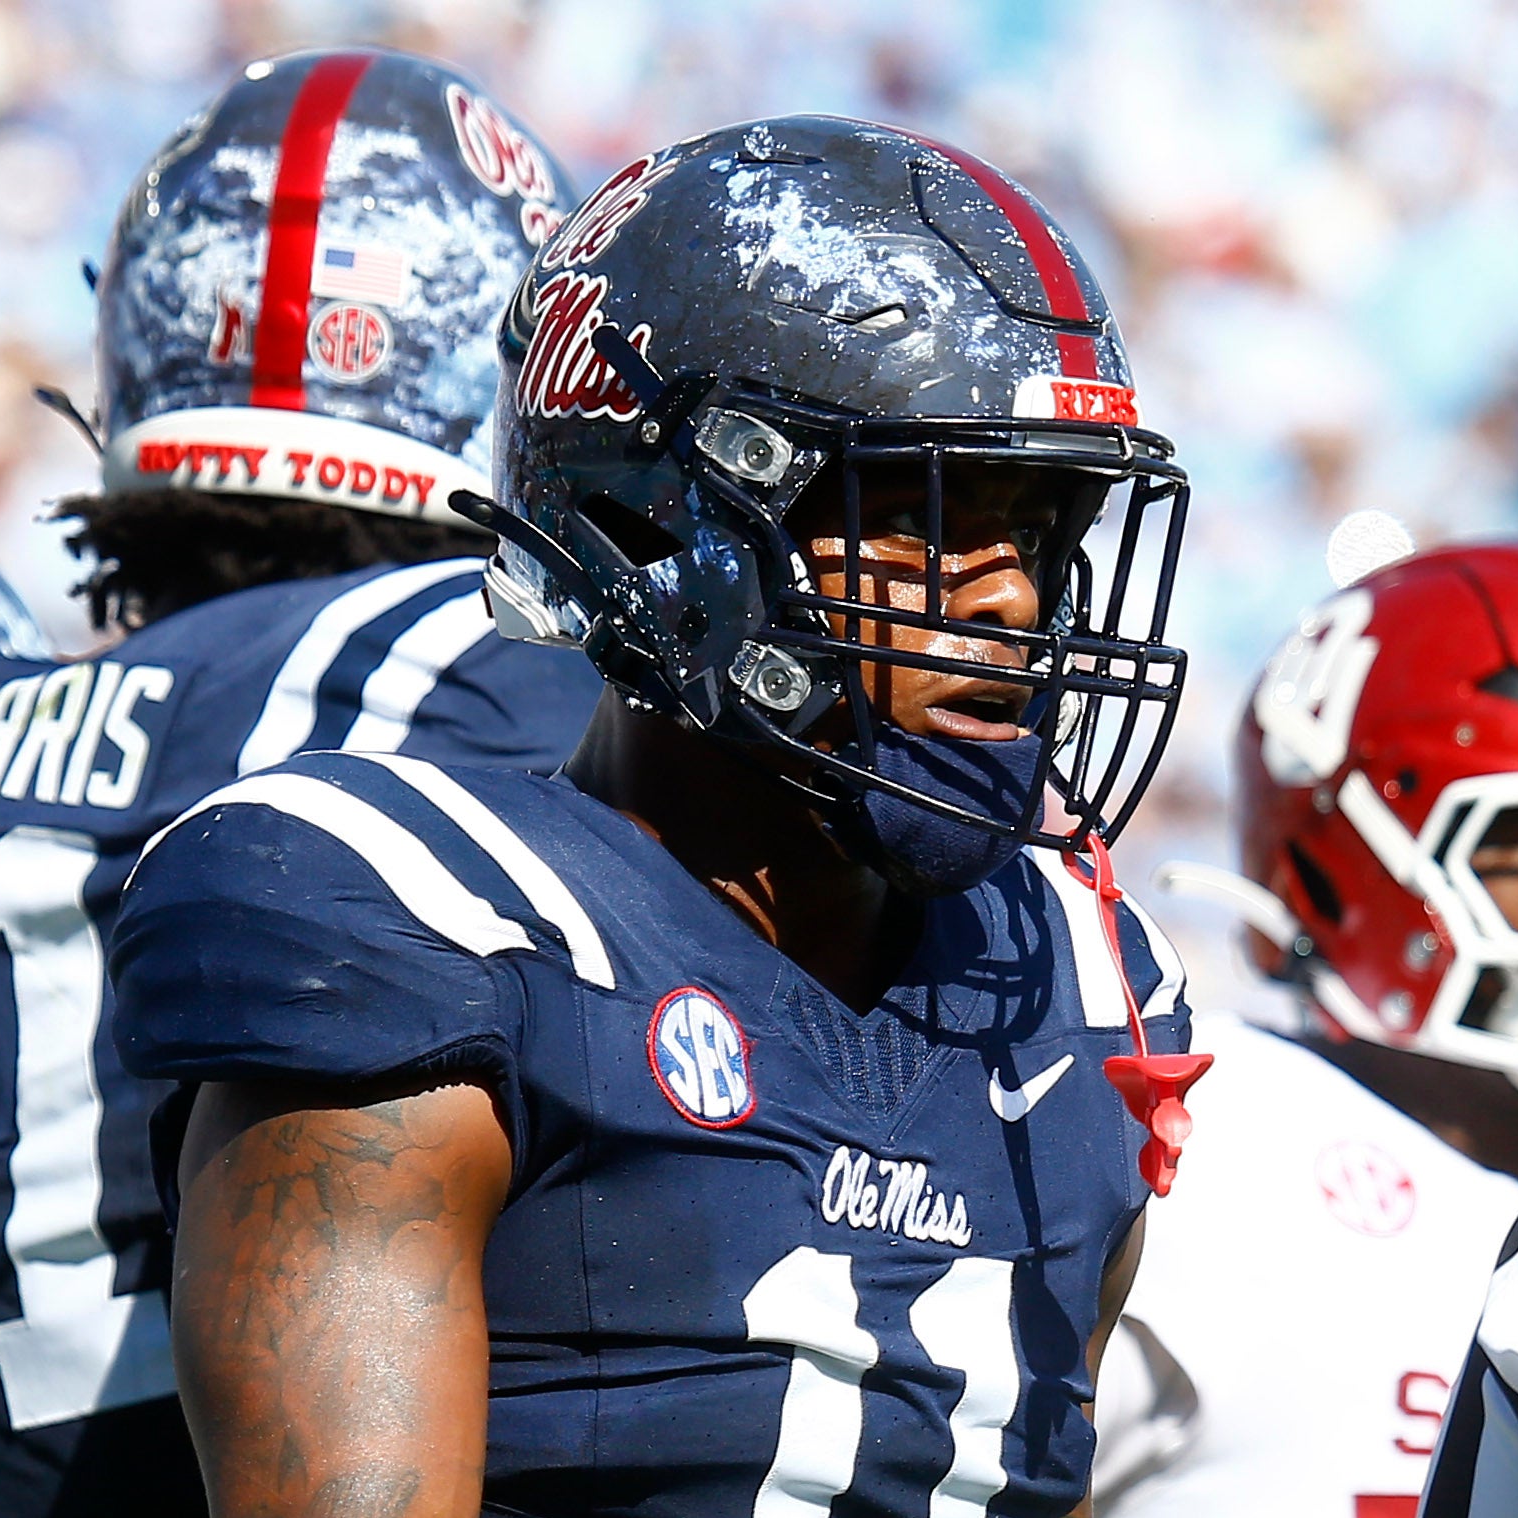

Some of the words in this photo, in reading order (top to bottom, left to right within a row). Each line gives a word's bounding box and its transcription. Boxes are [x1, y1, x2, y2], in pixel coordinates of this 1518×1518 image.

[317, 307, 384, 373] SEC
[285, 451, 436, 505] TODDY
[659, 995, 750, 1118] SEC
[820, 1145, 880, 1229] Ole
[877, 1159, 974, 1247] Miss
